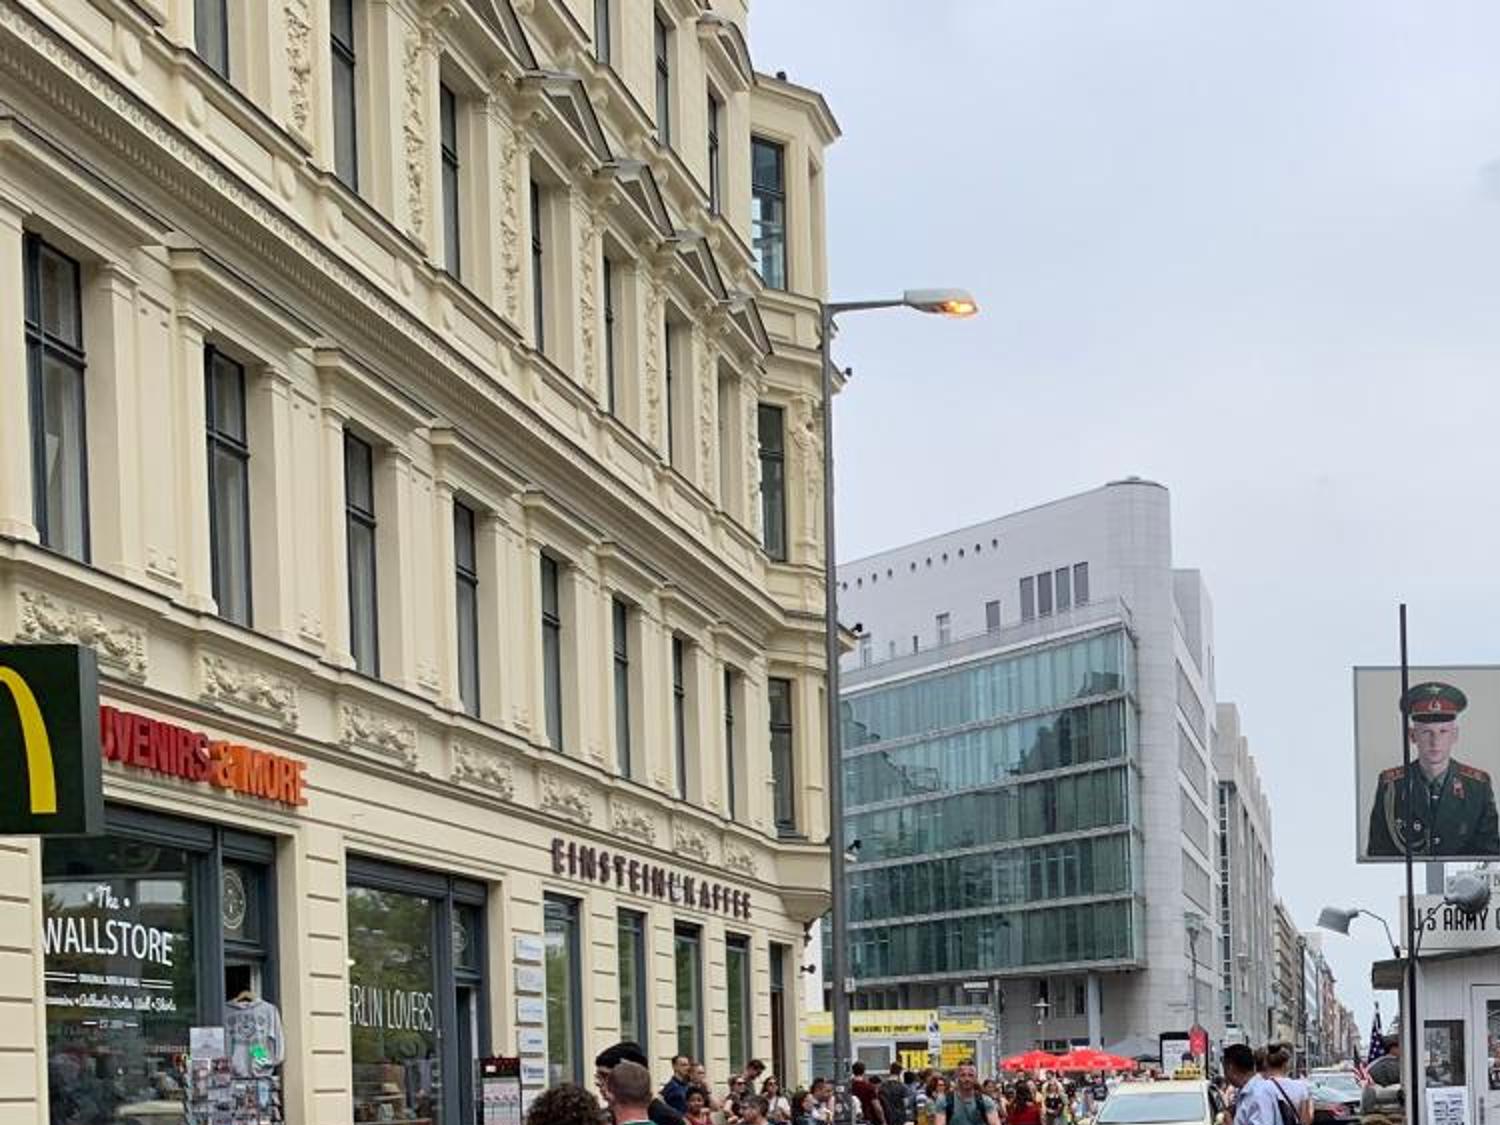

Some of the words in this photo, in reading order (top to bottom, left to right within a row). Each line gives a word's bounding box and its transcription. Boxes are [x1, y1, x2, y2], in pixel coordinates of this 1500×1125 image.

[210, 741, 236, 787] &
[238, 746, 309, 807] MORE
[96, 883, 120, 909] The
[551, 837, 665, 898] EINSTEIN
[684, 875, 752, 919] KAFFEE
[42, 917, 173, 966] WALLSTORE
[1443, 907, 1488, 931] ARMY
[387, 989, 433, 1031] LOVERS
